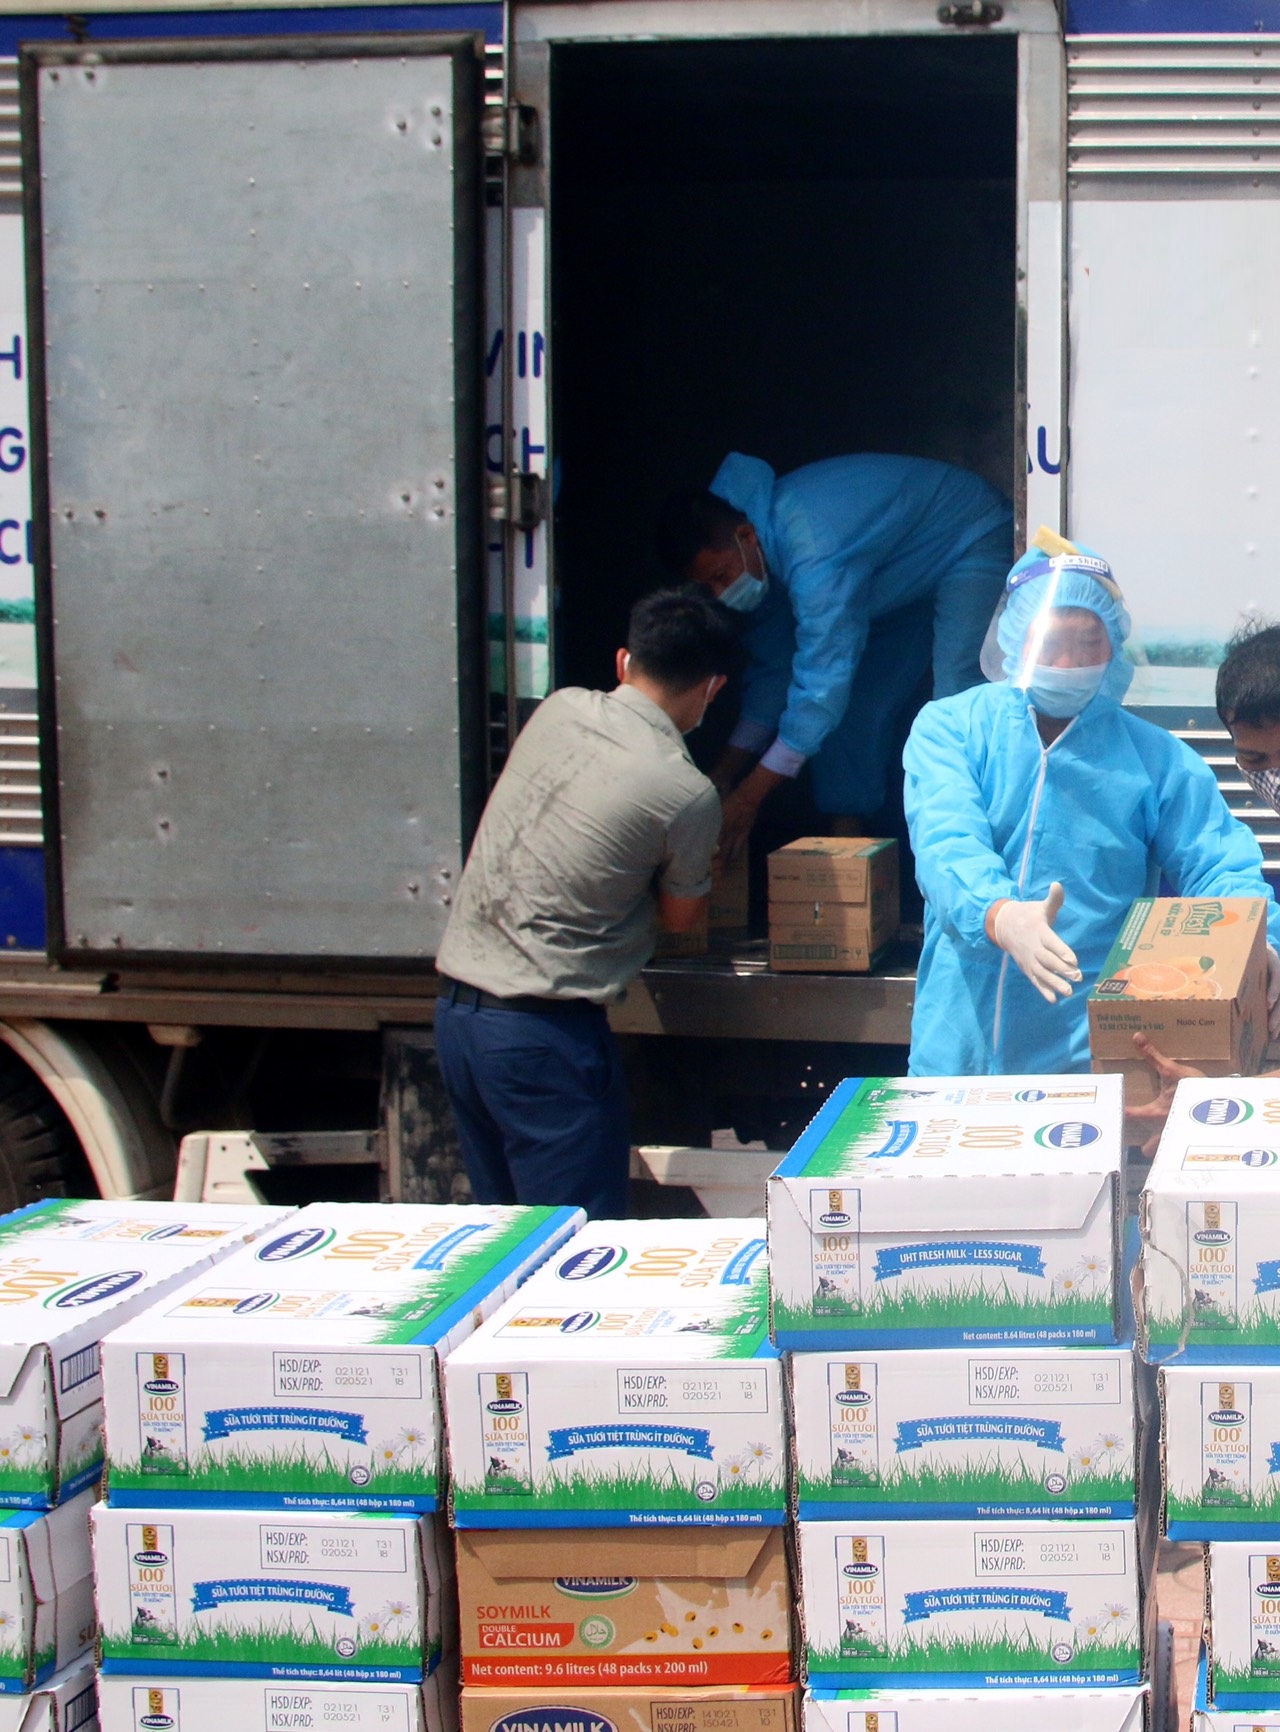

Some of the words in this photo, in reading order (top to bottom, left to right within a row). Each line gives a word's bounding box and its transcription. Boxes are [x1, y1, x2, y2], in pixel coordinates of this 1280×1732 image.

[1206, 1099, 1230, 1124] VINAMILK
[819, 1215, 849, 1223] VINAMILK
[1194, 1233, 1230, 1241] VINAMILK
[900, 1251, 917, 1264] UHT
[919, 1250, 945, 1262] FRESH
[947, 1249, 966, 1260] MILK
[973, 1249, 993, 1260] LESS
[995, 1250, 1022, 1262] SUGAR
[963, 1332, 974, 1340] Net
[976, 1332, 1002, 1340] content:
[1004, 1331, 1017, 1339] 8.64
[1019, 1331, 1035, 1339] litres
[1037, 1330, 1047, 1339] (48
[1048, 1330, 1066, 1339] packs
[1072, 1330, 1083, 1338] 180
[1085, 1329, 1096, 1339] ml)
[280, 1359, 322, 1373] HSD/EXP:
[335, 1367, 369, 1376] 021121
[391, 1368, 408, 1376] T31
[280, 1377, 323, 1391] NSX/PRD:
[335, 1377, 373, 1385] 020521
[623, 1376, 667, 1390] HSD/EXP:
[145, 1382, 179, 1391] VINAMILK
[682, 1382, 718, 1391] 021121
[740, 1382, 757, 1390] T31
[624, 1394, 668, 1408] NSX/PRD:
[682, 1392, 721, 1400] 020521
[837, 1393, 870, 1401] VINAMILK
[489, 1402, 522, 1411] VINAMILK
[1209, 1413, 1244, 1422] VINAMILK
[135, 1554, 168, 1562] VINAMILK
[844, 1566, 878, 1574] VINAMILK
[477, 1605, 551, 1619] SOYMILK
[482, 1632, 561, 1647] CALCIUM
[471, 1664, 493, 1675] Net
[496, 1664, 543, 1675] content:
[545, 1664, 563, 1675] 9.6
[566, 1663, 596, 1675] litres
[598, 1663, 617, 1677] (48
[620, 1664, 652, 1678] packs
[655, 1666, 662, 1674] x
[664, 1663, 686, 1674] 200
[688, 1662, 708, 1676] ml)
[271, 1696, 312, 1710] HSD/EXP:
[323, 1703, 358, 1713] 021121
[378, 1704, 395, 1713] T31
[323, 1712, 361, 1722] 020521
[656, 1708, 696, 1720] HSD/EXP:
[702, 1709, 736, 1719] 141021
[759, 1709, 777, 1717] T31
[140, 1717, 175, 1725] VINAMILK
[271, 1713, 314, 1728] NSX/PRD:
[703, 1719, 740, 1727] 150421
